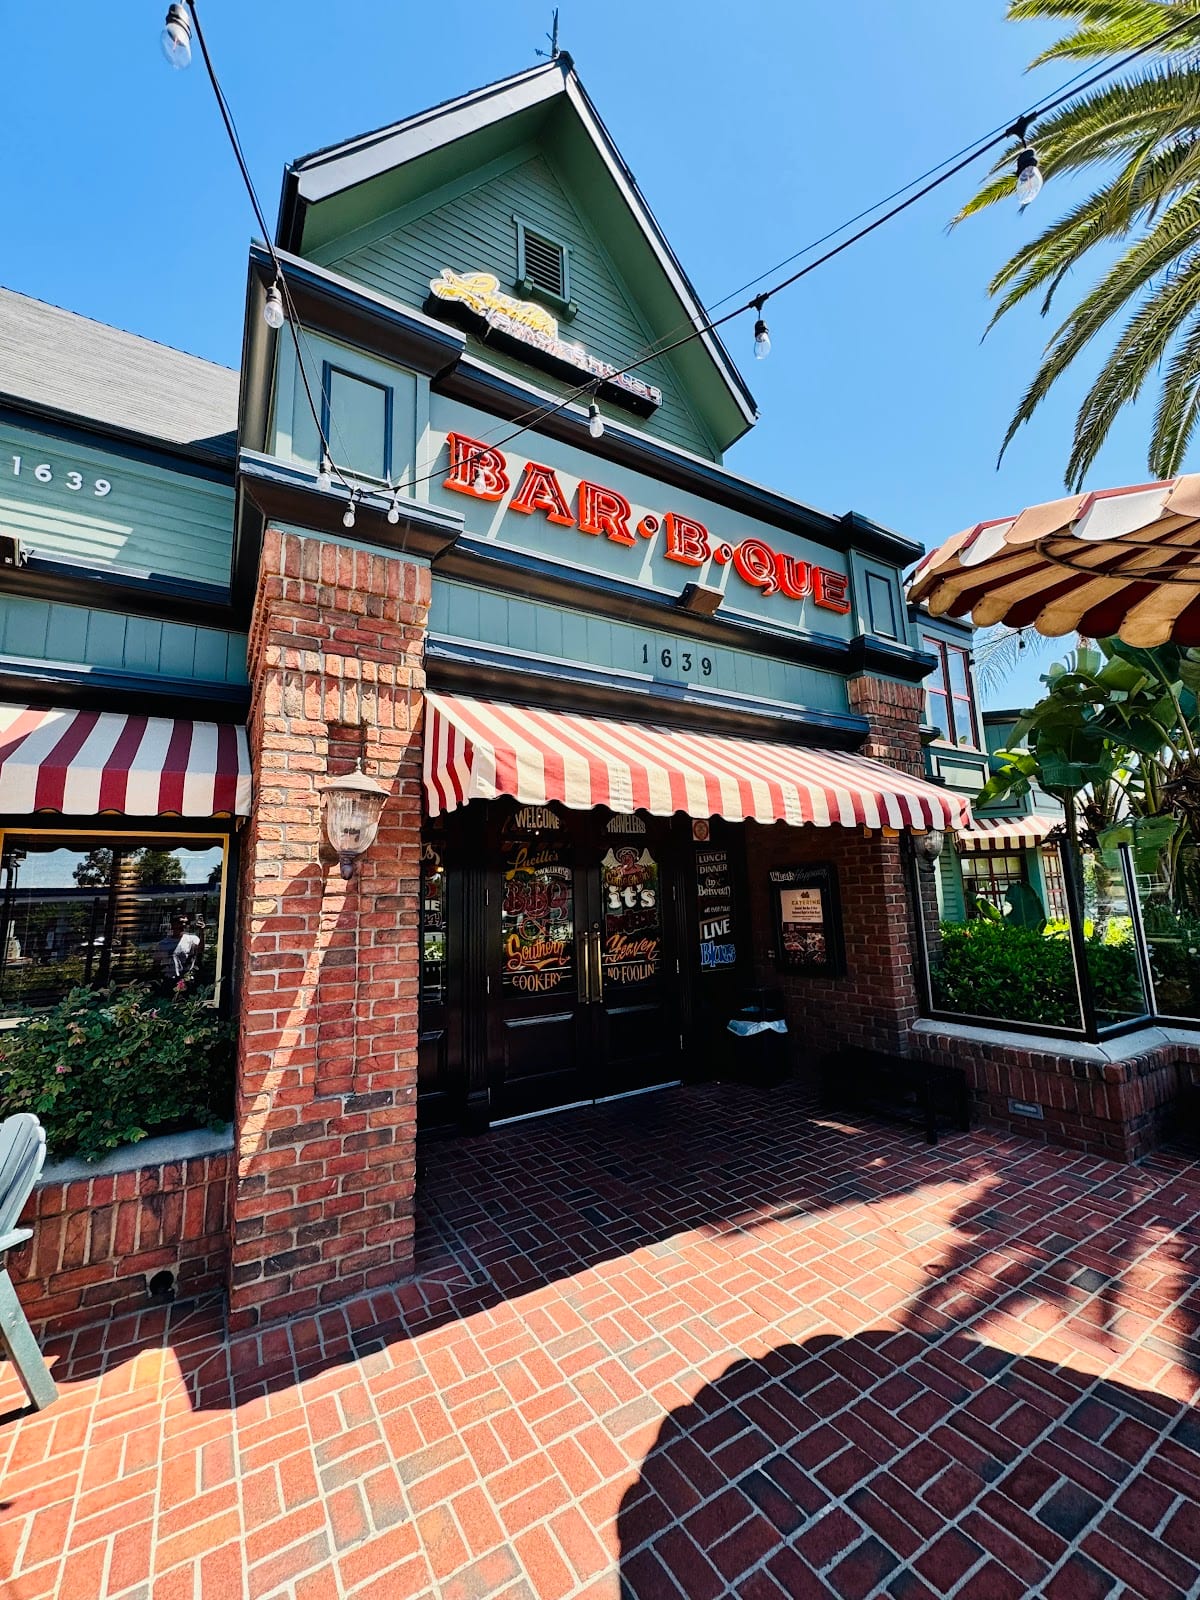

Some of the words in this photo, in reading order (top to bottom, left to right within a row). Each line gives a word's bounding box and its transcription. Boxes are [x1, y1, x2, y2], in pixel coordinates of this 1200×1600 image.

[11, 455, 112, 497] 1639
[641, 643, 713, 677] 1639
[514, 806, 560, 830] WELCOME
[606, 813, 647, 834] TRAVELERS
[698, 853, 728, 864] LUNCH
[699, 863, 728, 875] DINNER
[502, 879, 570, 920] BBQ
[607, 885, 657, 909] it's
[703, 918, 731, 940] LIVE
[506, 934, 571, 970] Southern
[512, 972, 564, 992] COOKERY
[607, 966, 619, 980] NO
